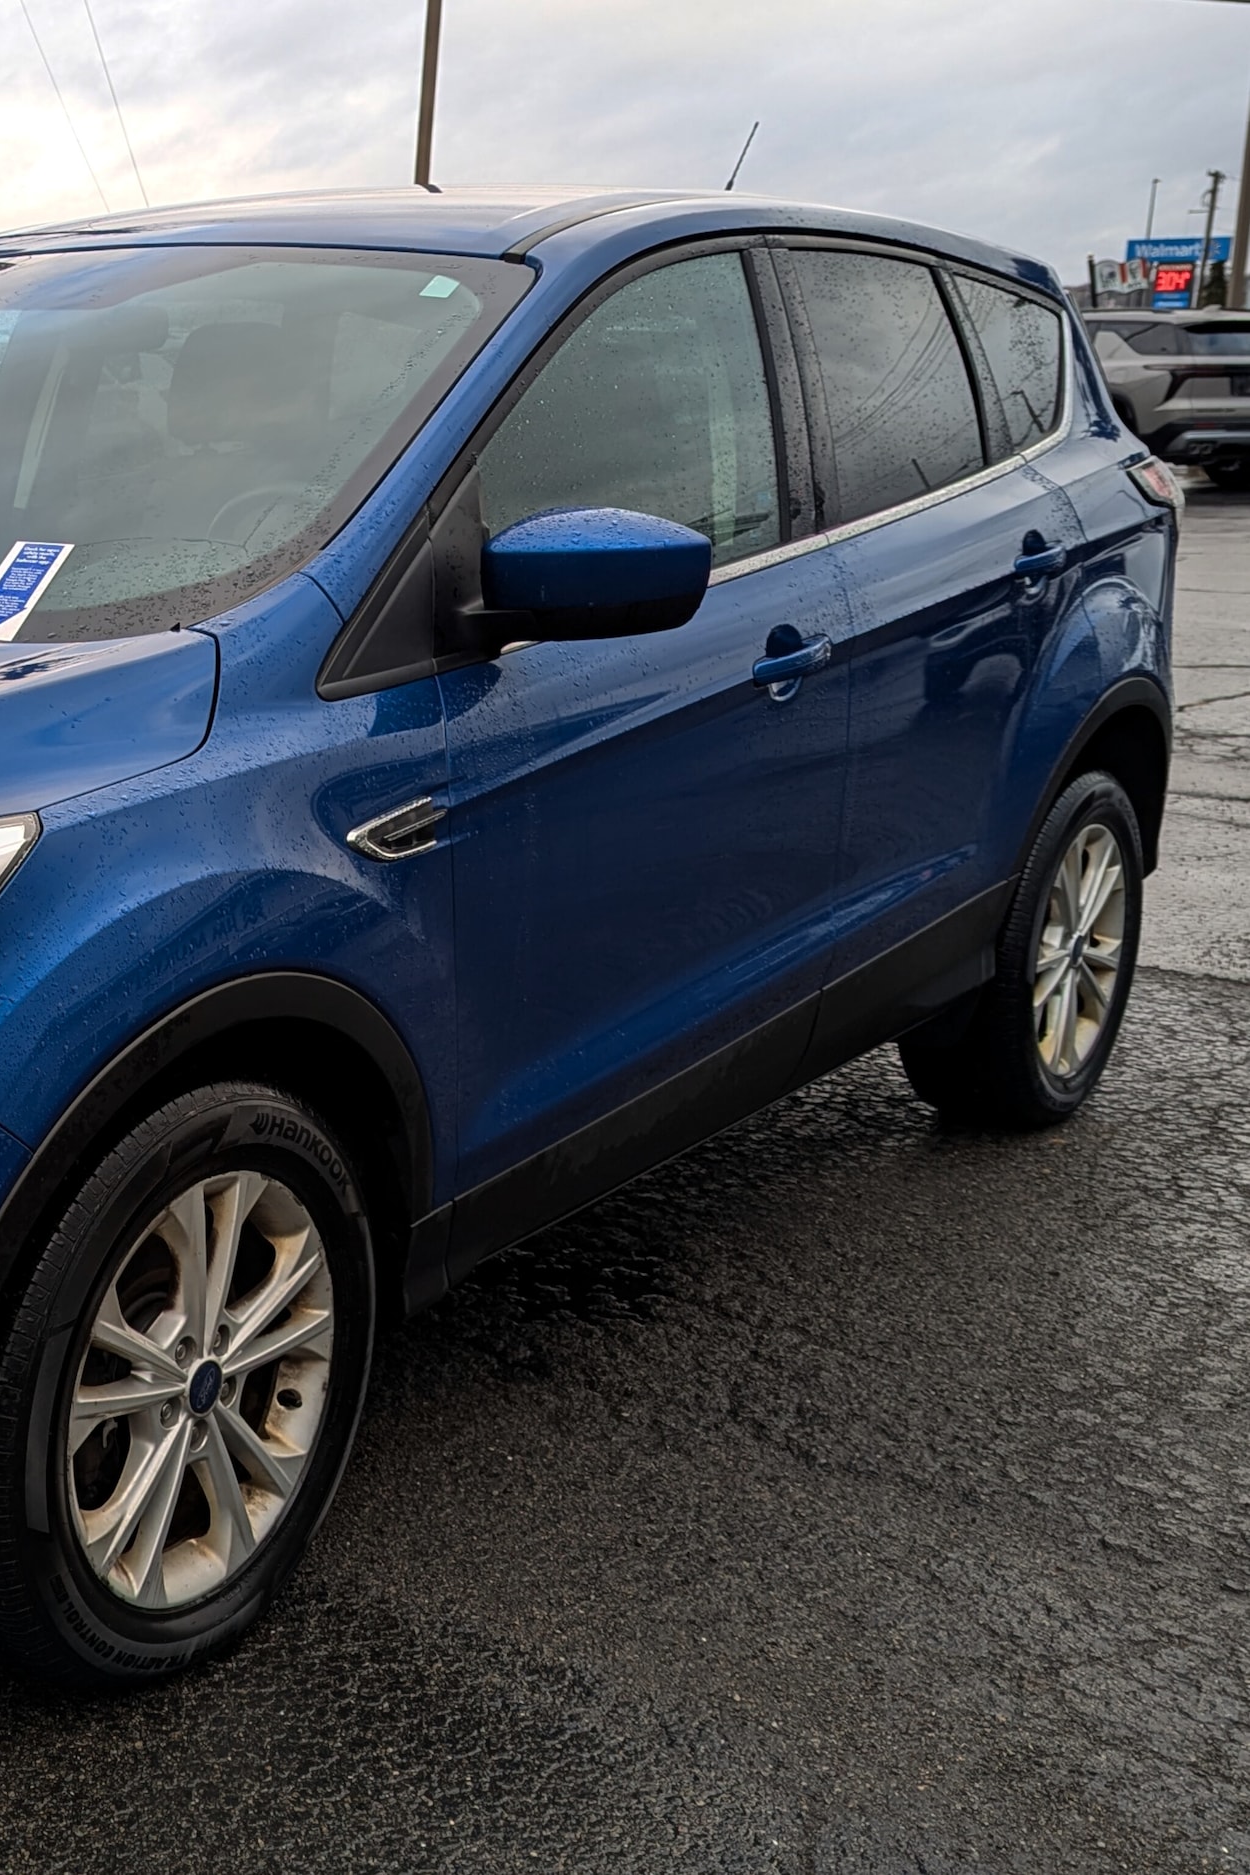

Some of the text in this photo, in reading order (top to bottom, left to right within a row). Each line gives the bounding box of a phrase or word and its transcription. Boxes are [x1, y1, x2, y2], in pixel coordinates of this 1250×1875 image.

[1134, 242, 1201, 258] Walmart
[62, 1601, 187, 1671] TRACTION CONTROL
